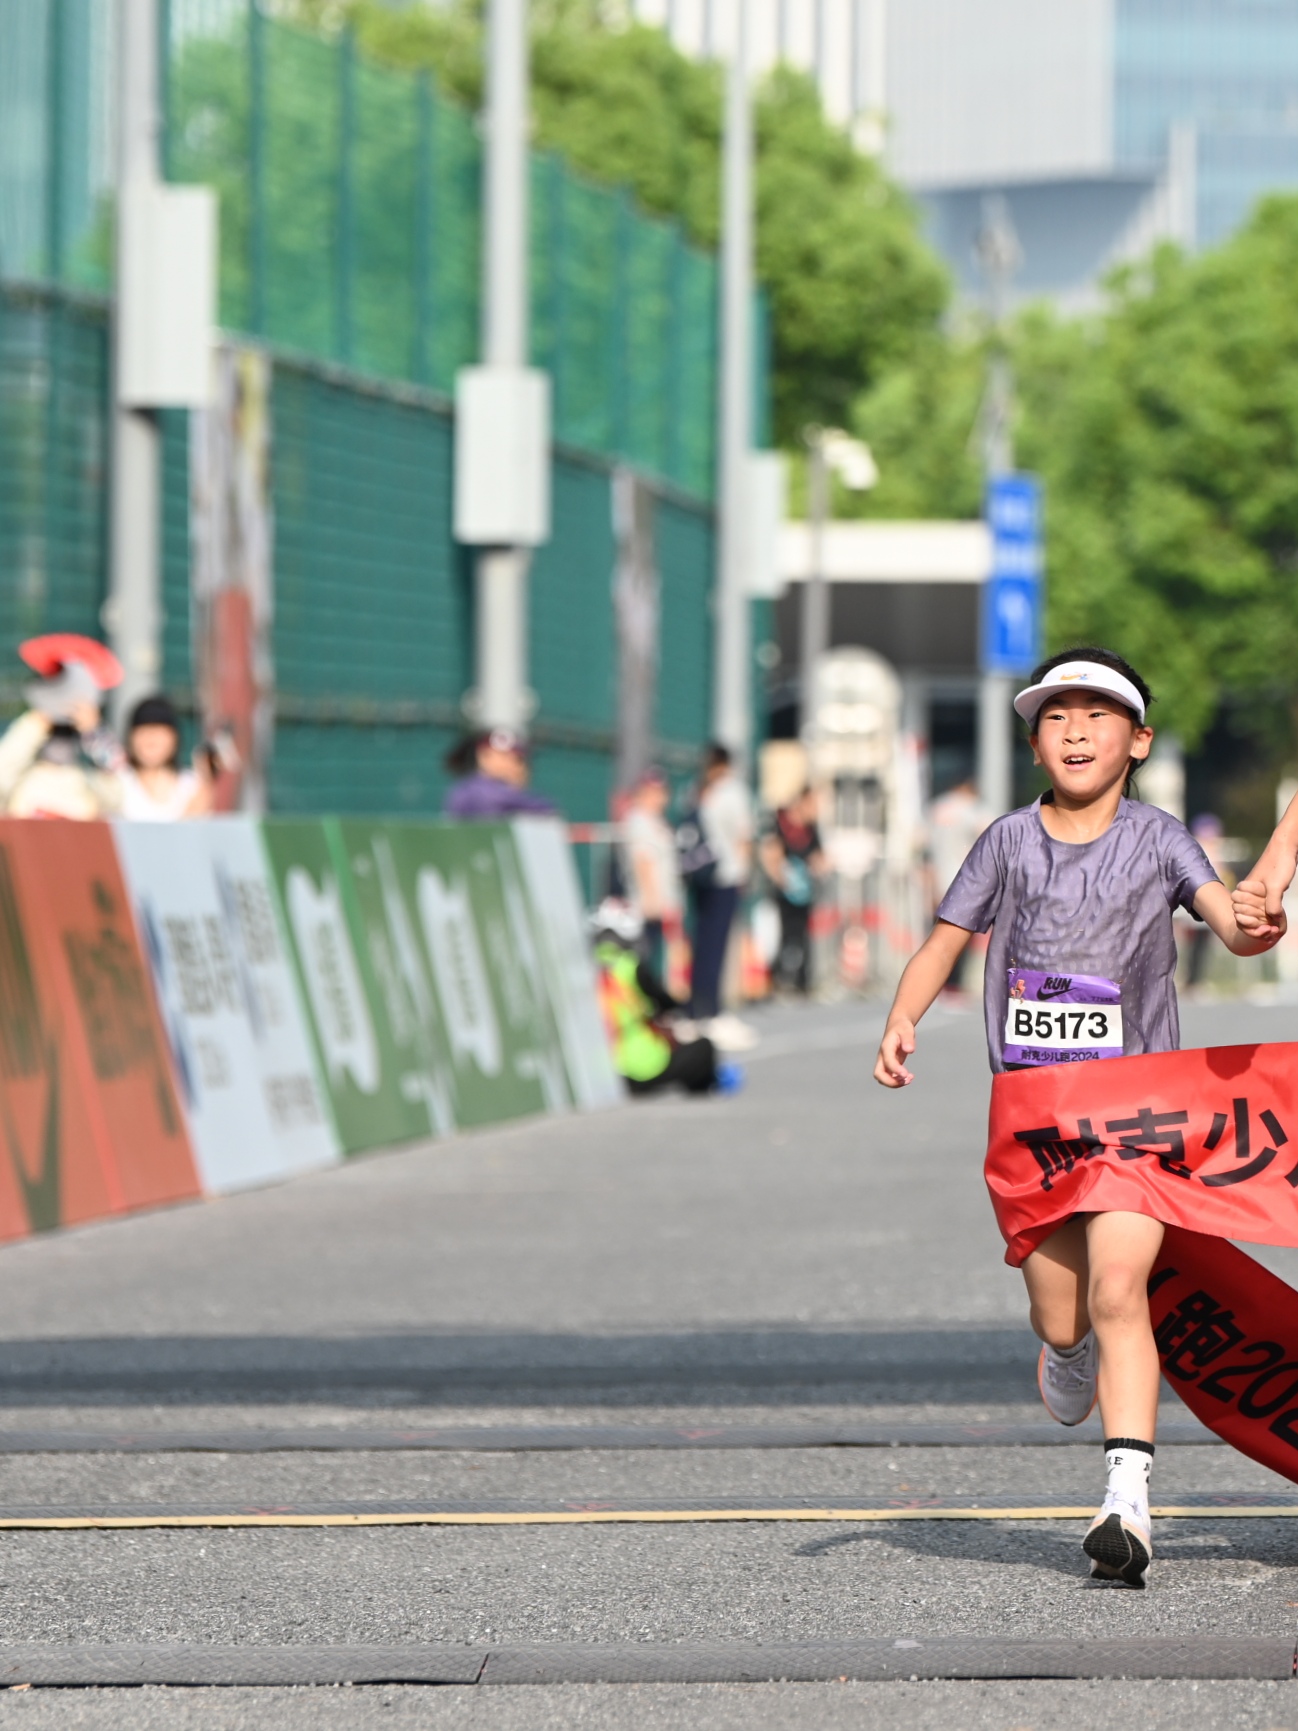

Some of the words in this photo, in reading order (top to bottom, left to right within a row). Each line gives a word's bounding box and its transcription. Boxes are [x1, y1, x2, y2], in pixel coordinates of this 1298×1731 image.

[1043, 976, 1073, 991] RUN
[1014, 1009, 1109, 1040] B5173
[1021, 1049, 1100, 1062] 耐克少儿跑2024
